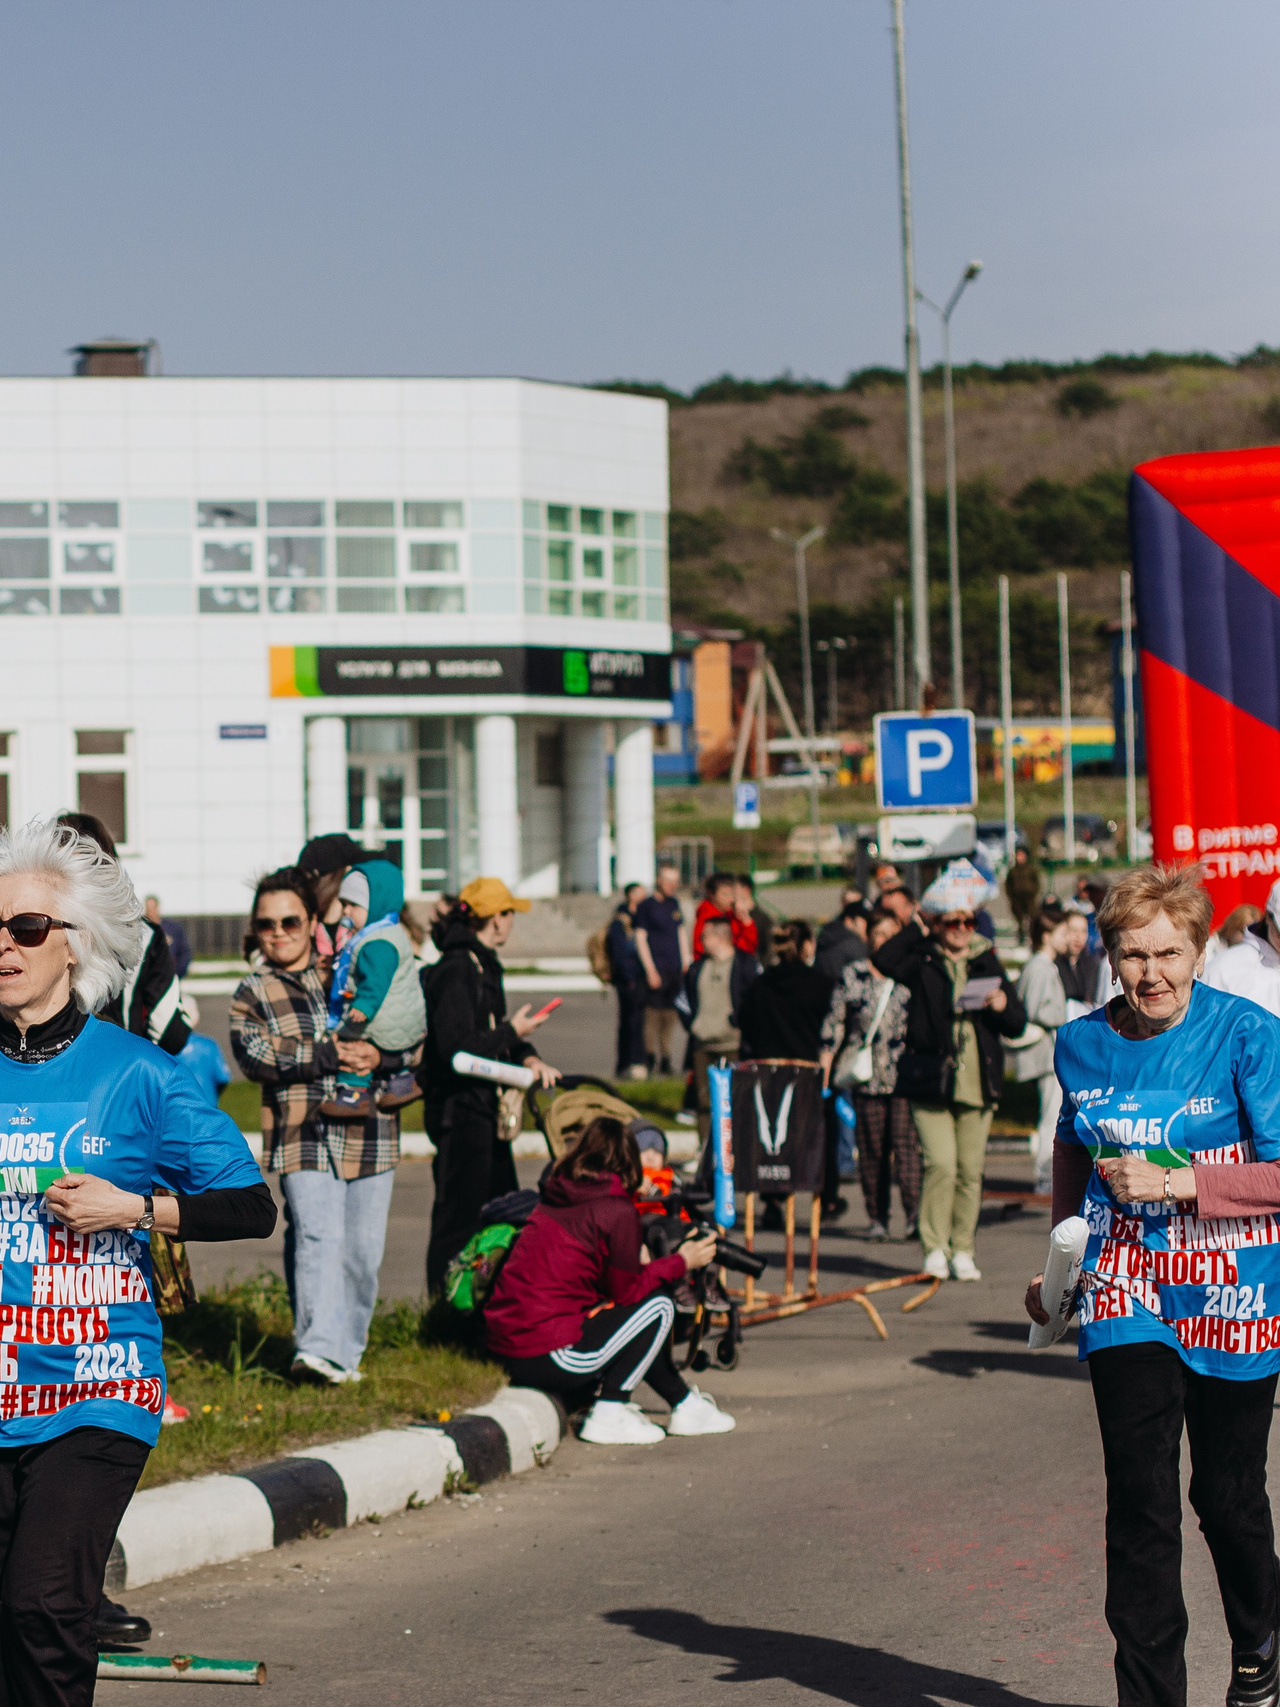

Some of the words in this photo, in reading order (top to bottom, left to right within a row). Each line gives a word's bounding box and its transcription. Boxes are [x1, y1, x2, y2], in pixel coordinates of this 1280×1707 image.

[906, 729, 953, 797] P
[1173, 825, 1194, 851] В
[1097, 1118, 1162, 1146] 10045
[1095, 1239, 1238, 1286] #ГОРДОСТЬ
[1203, 1283, 1266, 1319] 2024
[1157, 1315, 1280, 1355] ДИНСТВО
[74, 1341, 144, 1382] 2024
